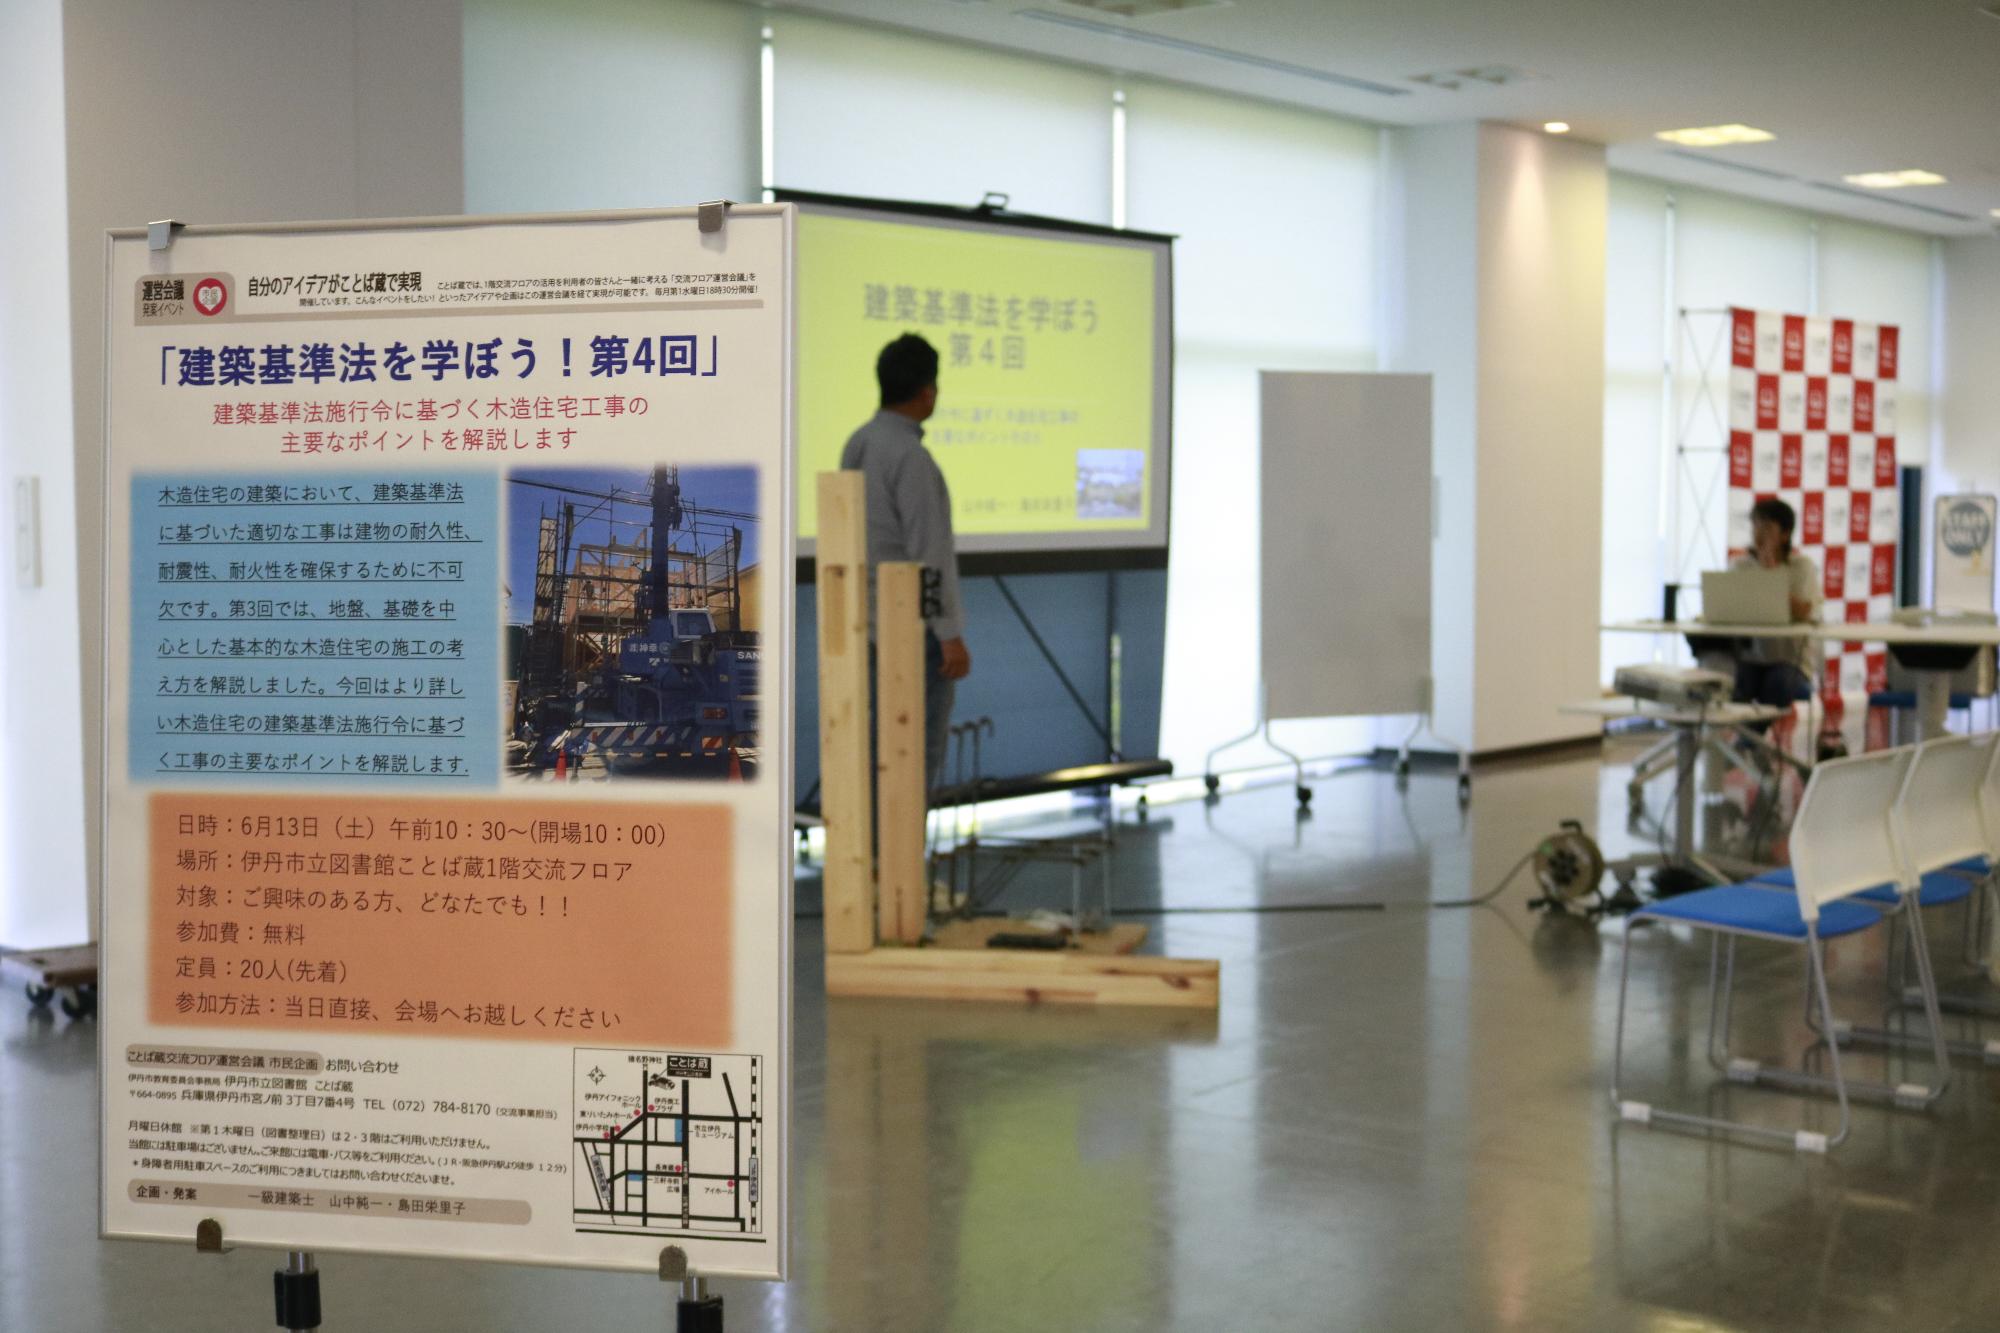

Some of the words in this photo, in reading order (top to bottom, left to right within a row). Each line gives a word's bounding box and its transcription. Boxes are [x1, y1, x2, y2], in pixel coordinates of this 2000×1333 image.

[142, 279, 184, 301] 運営会議
[248, 272, 422, 298] 自分のアイデアがことば蔵で実現
[212, 395, 649, 426] 建築基準法施行令に基づく木造住宅工事の
[280, 427, 578, 454] 主要なポイントを解説します
[158, 483, 465, 504] 木造住宅の建築において、建築基準法
[159, 521, 474, 543] に基づいた適切な工事は建物の耐久性、
[158, 560, 464, 581] 耐震性、耐火性を確保するために不可
[158, 599, 455, 619] 欠です。第3回では、地盤、基礎を中
[158, 638, 464, 658] 心とした基本的な木造住宅の施工の考
[157, 676, 464, 696] え方を解説しました。今回はより詳し
[157, 714, 466, 735] い木造住宅の建築基準法施行令に基づ
[176, 920, 305, 946] 参加費：無料
[175, 991, 621, 1029] 参加方法：当日直接、会場へお越しください
[127, 1050, 265, 1069] ことば蔵交流フロア運営会議
[269, 1057, 318, 1071] 市民企画
[325, 1058, 399, 1074] お問い合わせ
[224, 1075, 307, 1091] 伊丹市立図書館
[128, 1120, 183, 1134] 月曜日休館
[248, 1190, 315, 1207] 一級建築士
